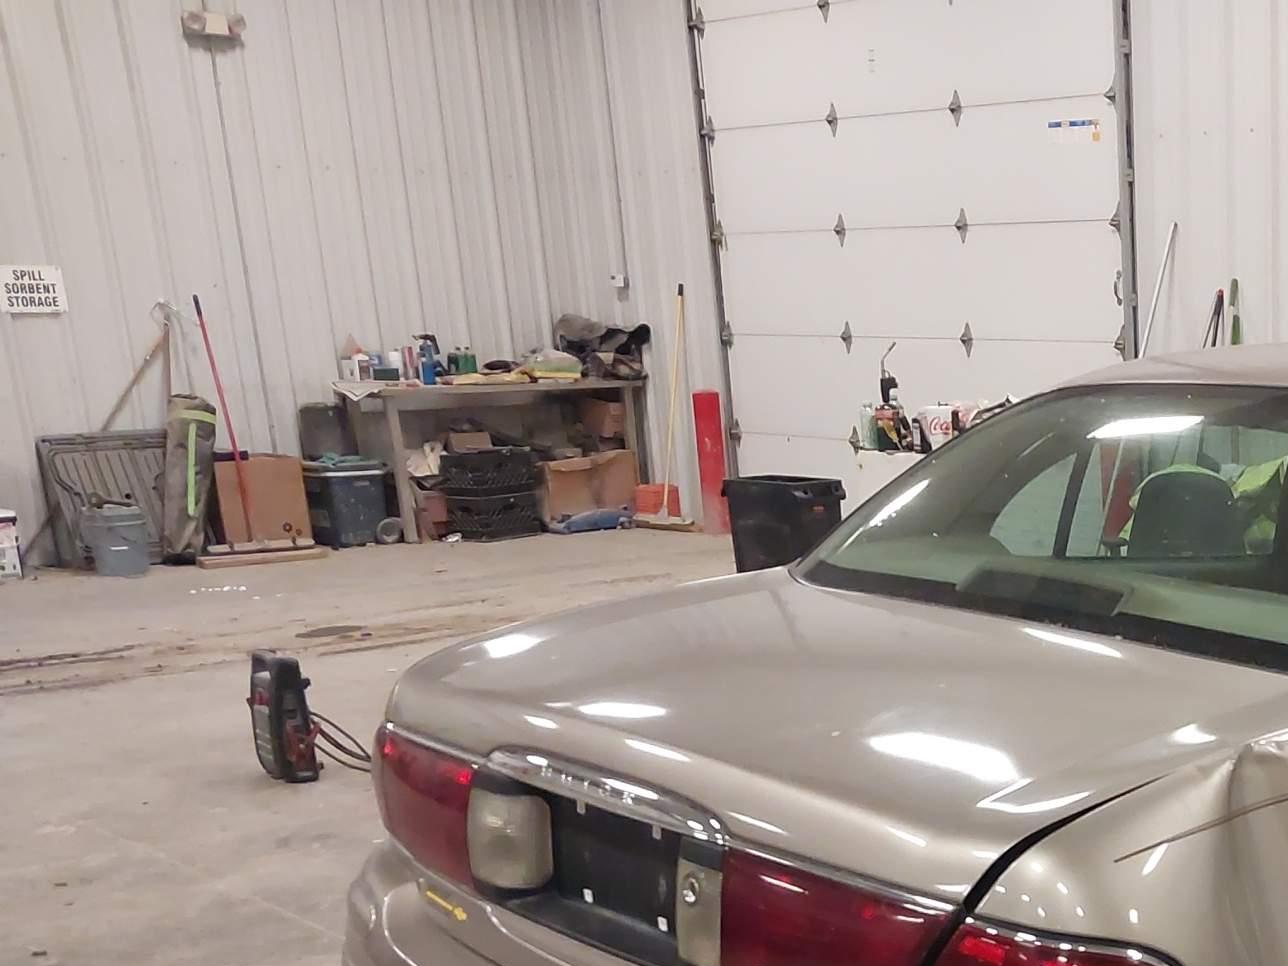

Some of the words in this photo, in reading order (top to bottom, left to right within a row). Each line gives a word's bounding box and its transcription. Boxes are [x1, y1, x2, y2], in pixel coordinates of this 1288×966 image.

[12, 269, 45, 281] SPILL
[4, 282, 57, 294] SORBENT
[7, 295, 60, 307] STORAGE
